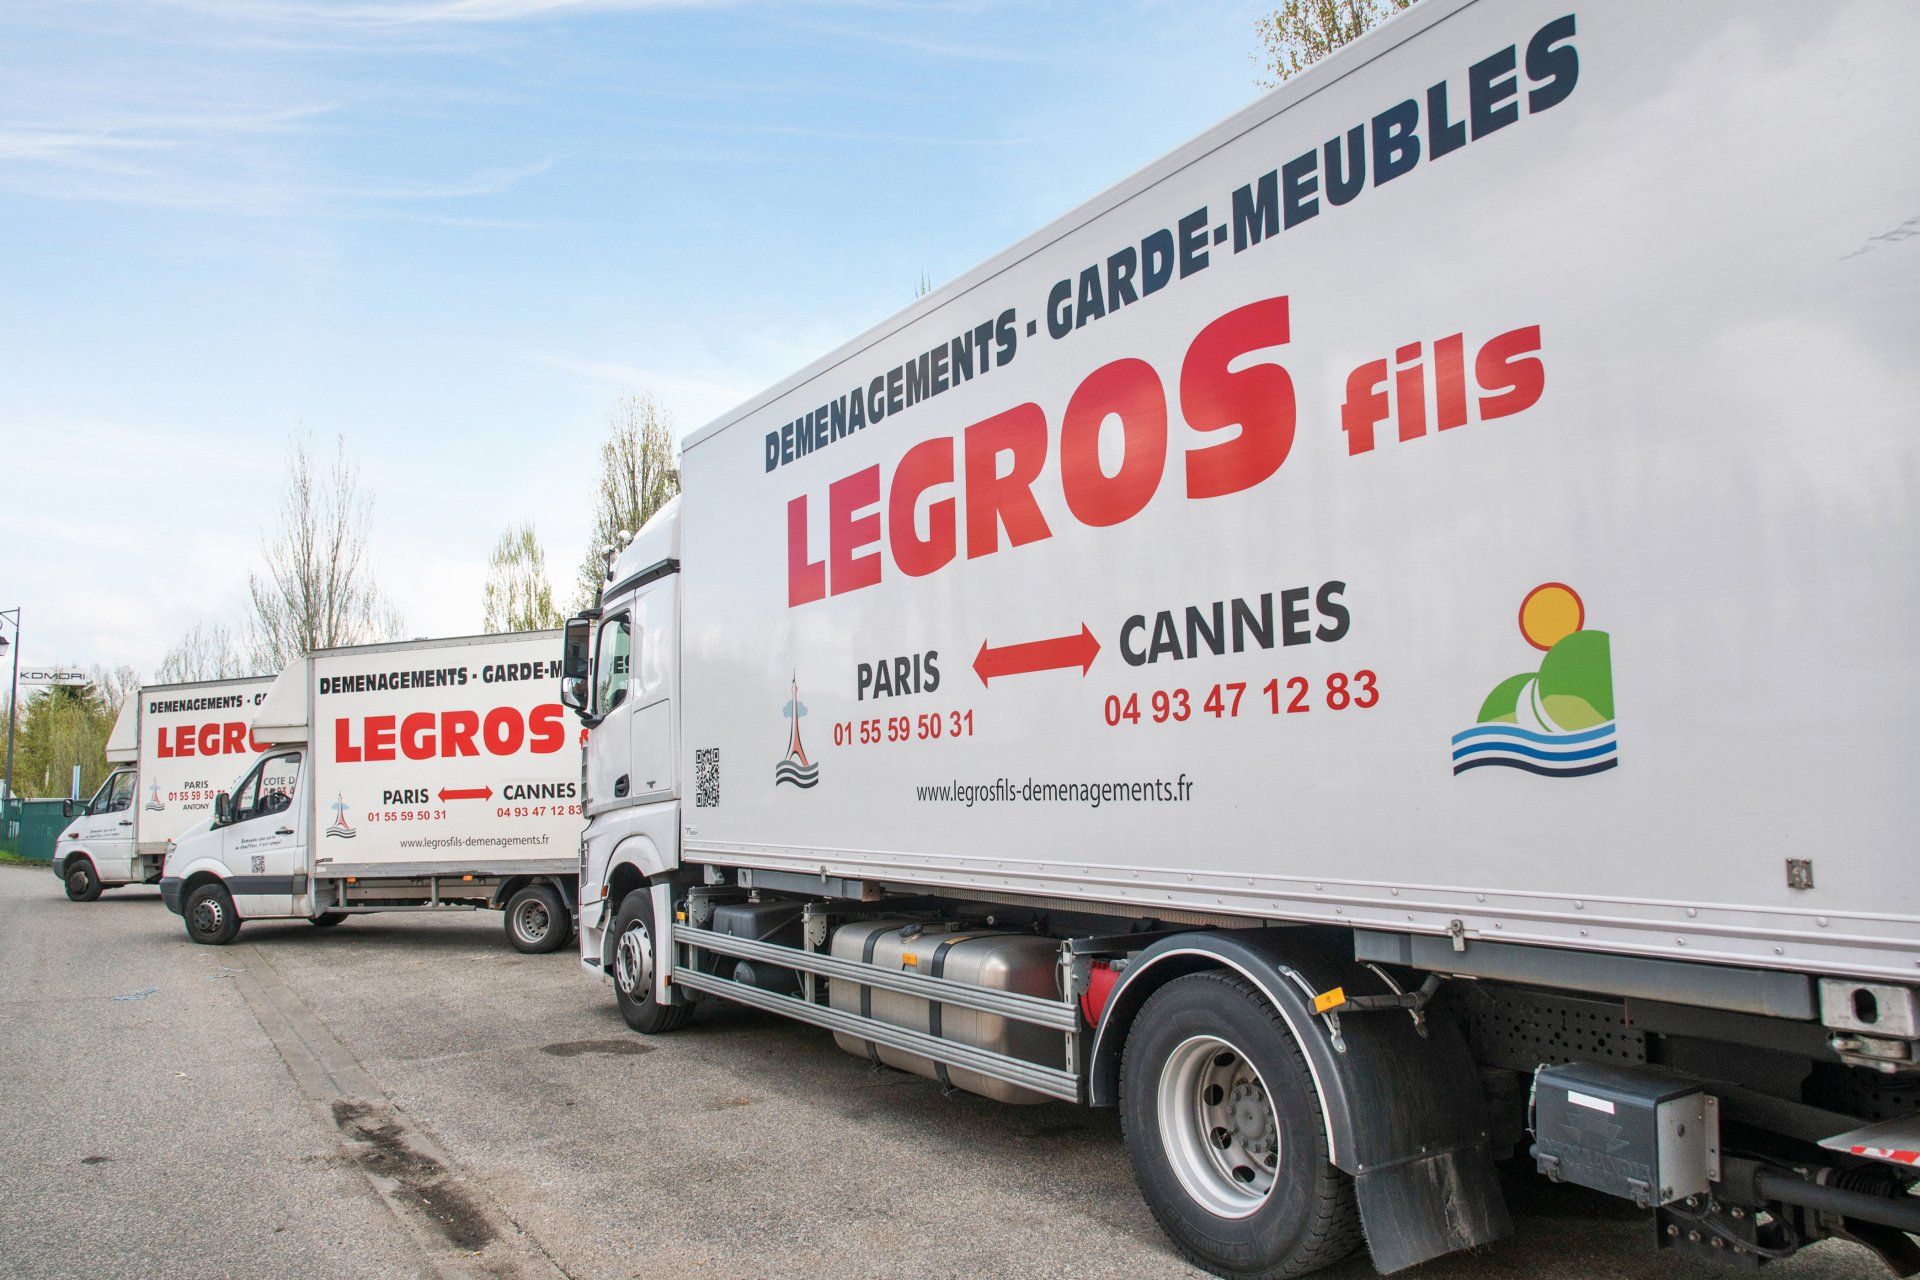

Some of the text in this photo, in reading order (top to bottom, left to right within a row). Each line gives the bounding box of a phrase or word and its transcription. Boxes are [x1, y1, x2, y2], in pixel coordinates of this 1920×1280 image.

[765, 14, 1579, 473] DEMENAGEMENTS GARDE-MEUBLES
[788, 295, 1545, 608] LEGROS fils
[857, 580, 1350, 701] PARIS CANNES
[20, 672, 86, 680] KOMORI
[320, 667, 468, 695] DEMENAGEMENTS
[150, 695, 243, 714] DEMENAGEMENTS
[1104, 669, 1380, 726] 04 93 47 12 83
[335, 703, 566, 763] LEGROS
[833, 709, 973, 747] 01 55 59 50 31
[184, 780, 209, 790] PARIS
[263, 776, 286, 786] COTE
[916, 773, 1193, 808] www.legrosfils-demenagements.fr
[168, 791, 178, 802] 01
[179, 791, 189, 801] 55
[191, 790, 201, 801] 59
[204, 790, 214, 800] 50
[383, 782, 576, 805] PARIS CANNES
[182, 803, 210, 811] ANTONY
[367, 809, 446, 822] 01 55 59 50 31
[497, 804, 583, 817] 04 93 47 12 83
[400, 834, 550, 850] www.legrosfils-demenagements.fr
